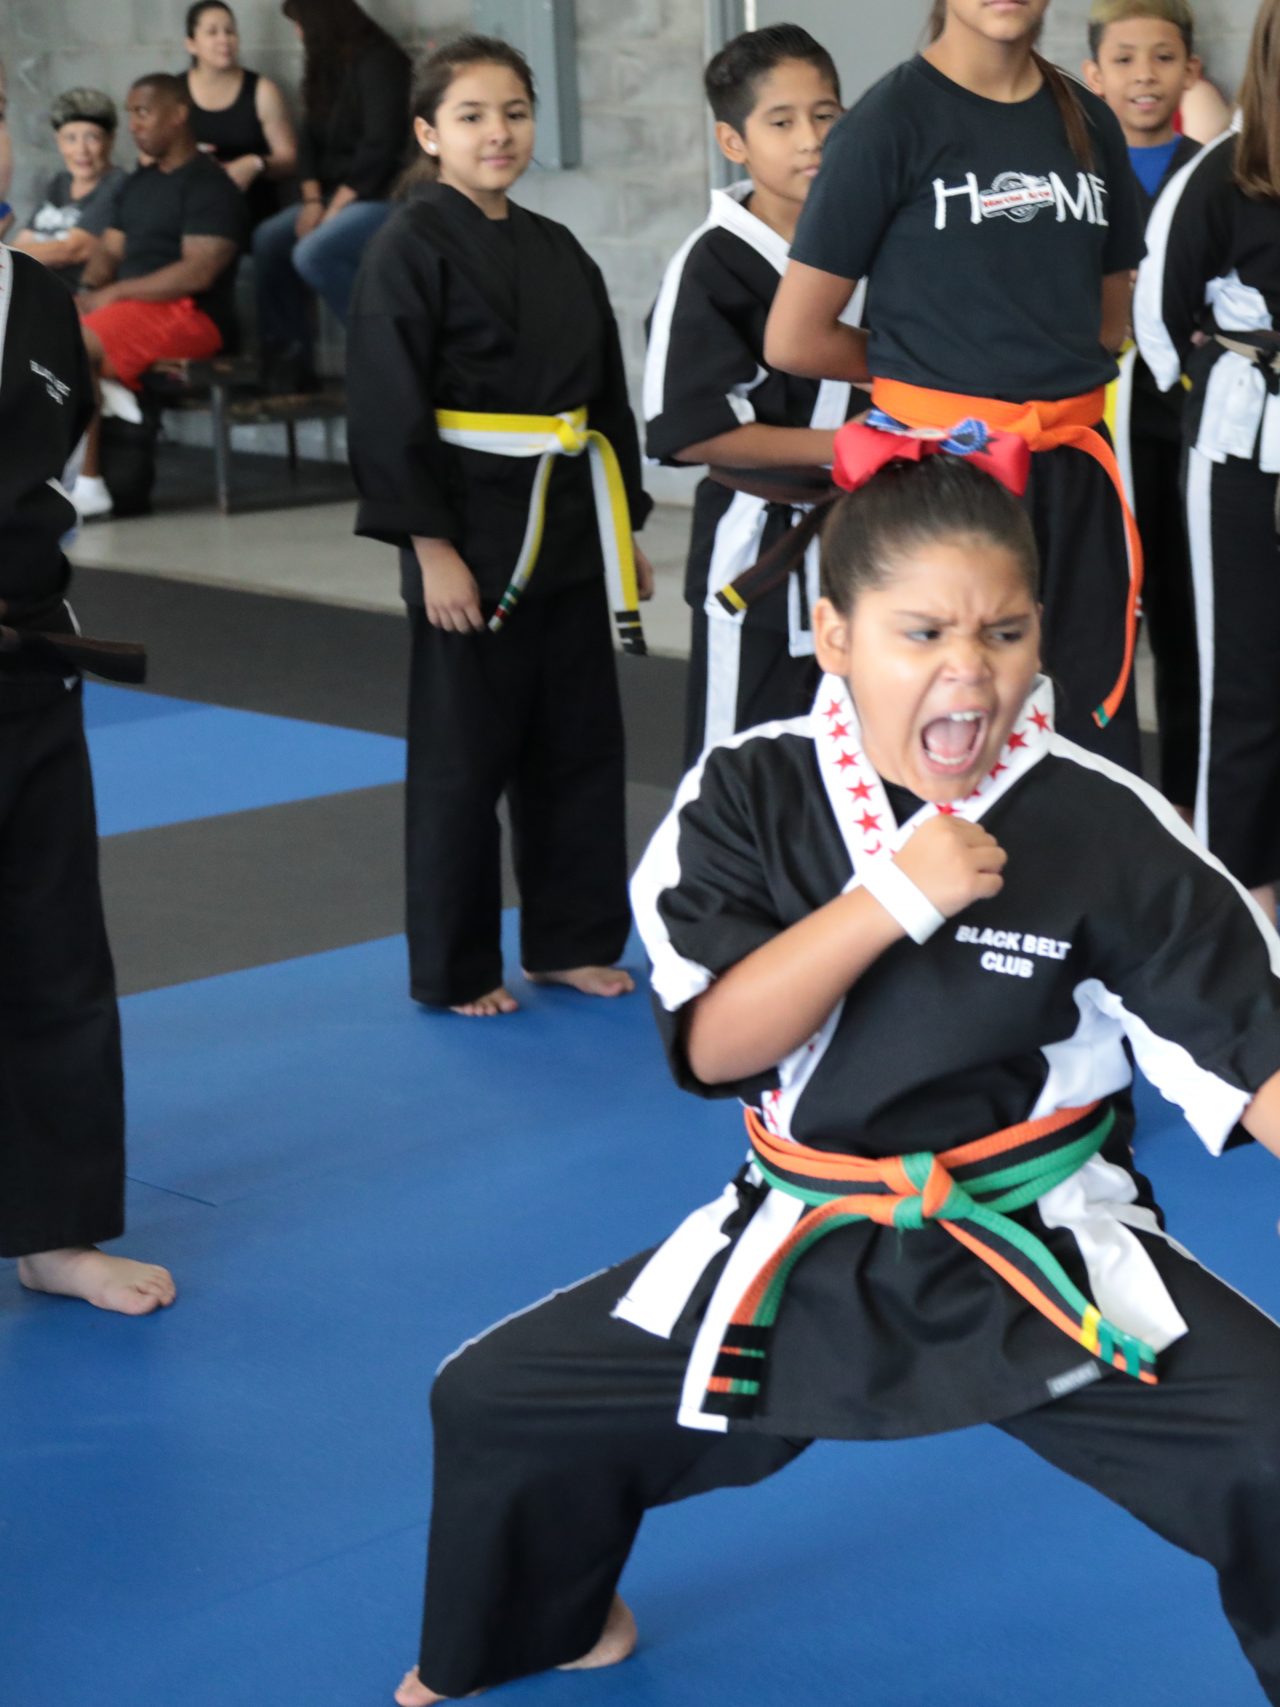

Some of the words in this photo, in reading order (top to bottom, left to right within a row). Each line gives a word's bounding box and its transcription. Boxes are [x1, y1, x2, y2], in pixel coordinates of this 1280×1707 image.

[955, 925, 1021, 951] BLACK
[1022, 934, 1072, 960] BELT
[980, 951, 1034, 978] CLUB
